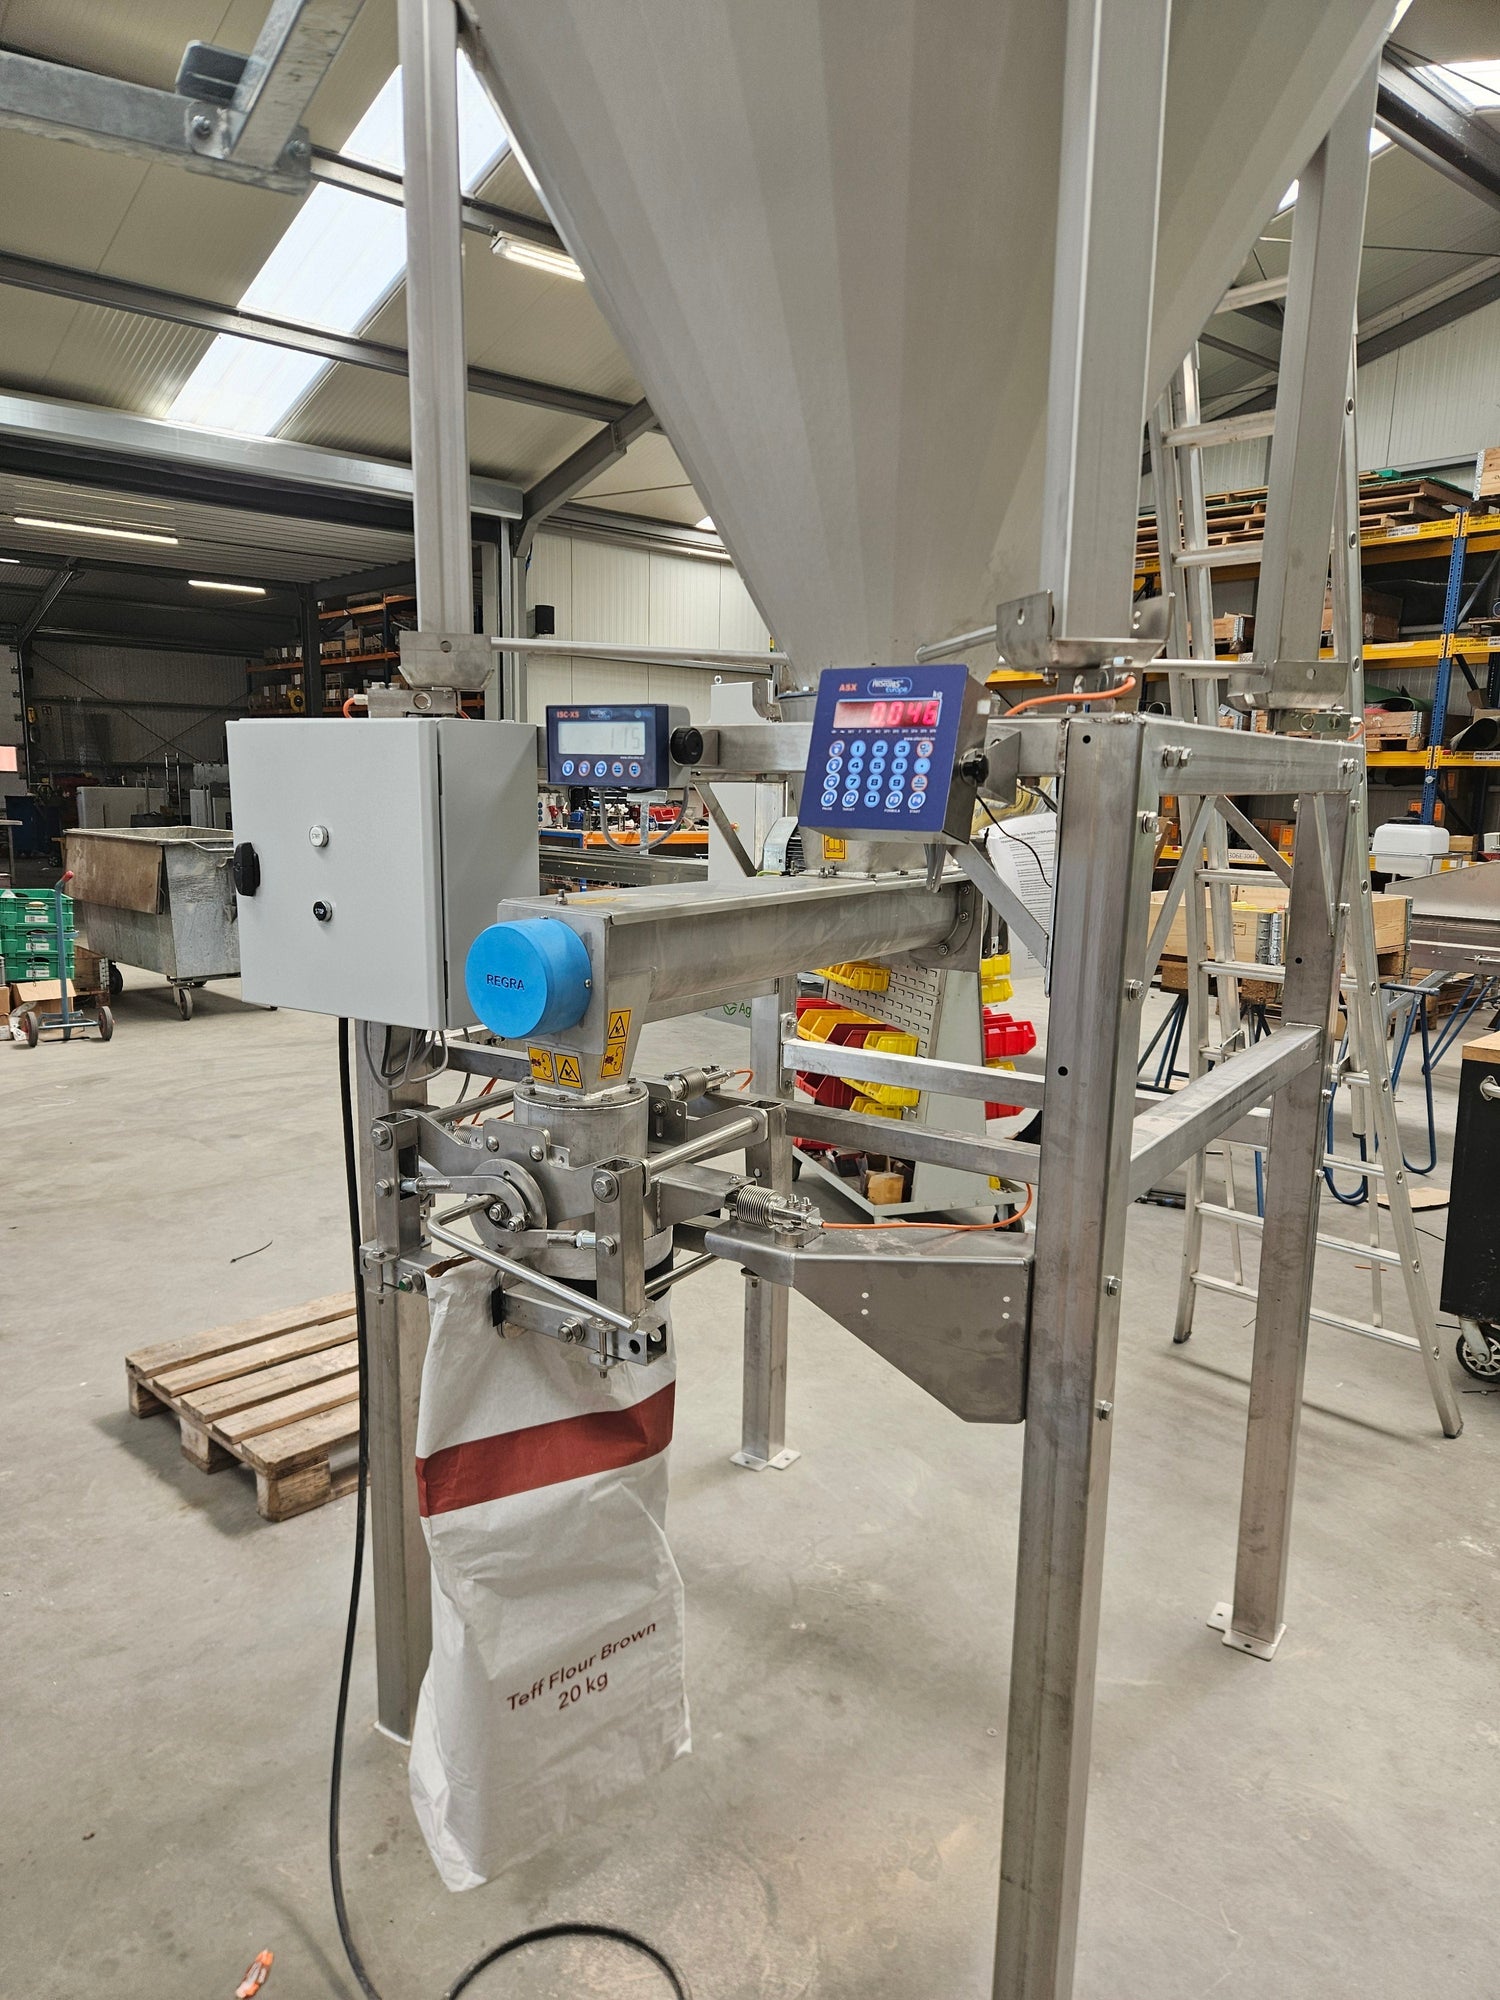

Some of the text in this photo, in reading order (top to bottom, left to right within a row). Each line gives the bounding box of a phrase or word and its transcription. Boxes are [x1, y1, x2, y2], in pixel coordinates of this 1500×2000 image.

[839, 683, 858, 692] ASX
[876, 745, 884, 753] 2
[898, 745, 906, 753] 3
[873, 762, 881, 770] 5
[895, 762, 904, 770] 6
[849, 778, 857, 786] 7
[893, 779, 901, 787] 9
[486, 974, 525, 991] REGRA
[507, 1622, 656, 1710] Teff Flour Brown
[558, 1672, 608, 1710] 20 kg
